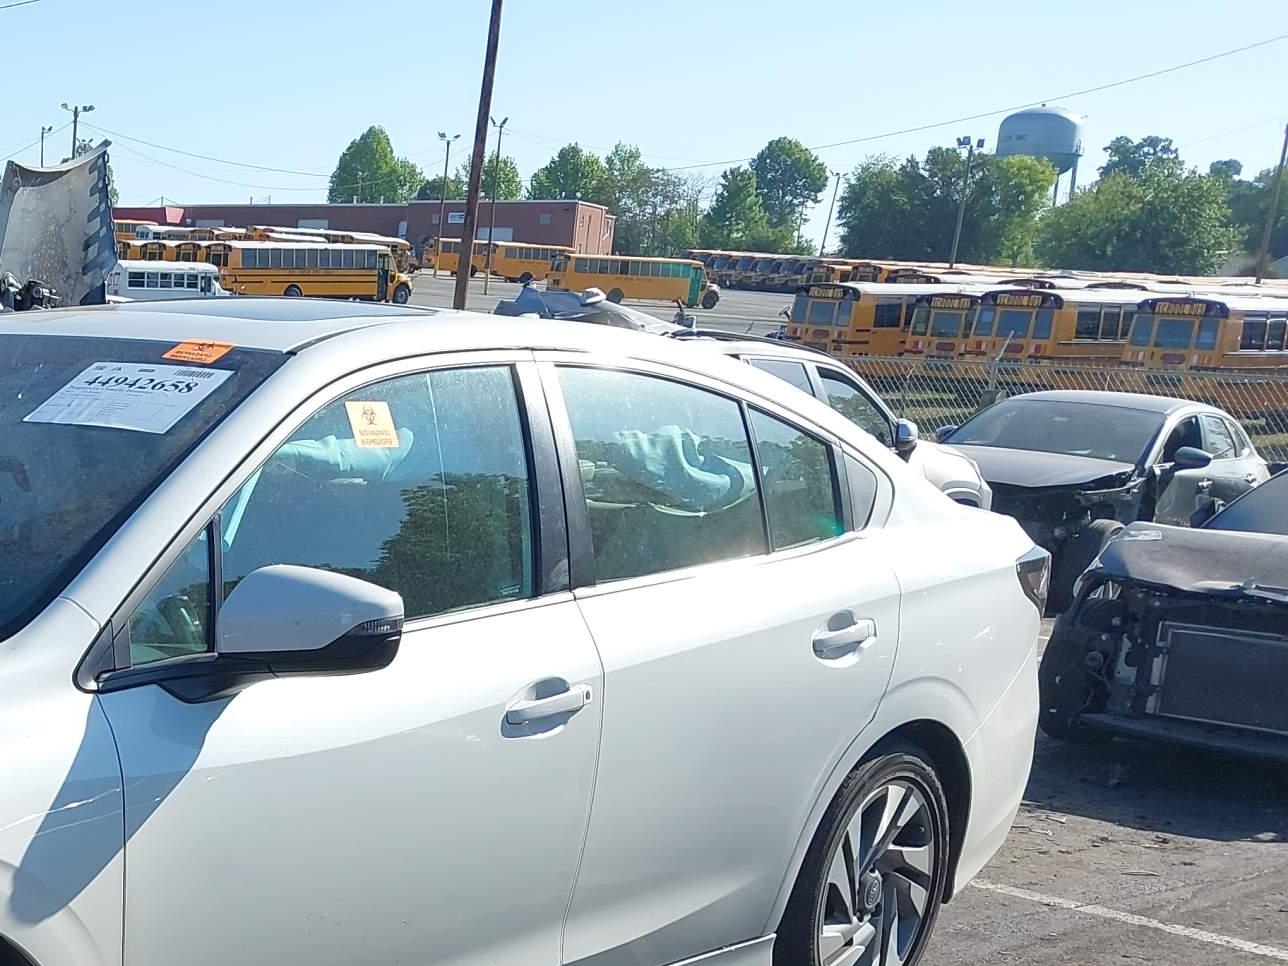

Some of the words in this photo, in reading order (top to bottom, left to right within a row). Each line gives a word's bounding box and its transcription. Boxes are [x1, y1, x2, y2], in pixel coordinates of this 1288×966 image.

[997, 293, 1029, 305] SCHOOL
[1155, 302, 1192, 315] SCHOOL
[84, 374, 199, 394] 44942658
